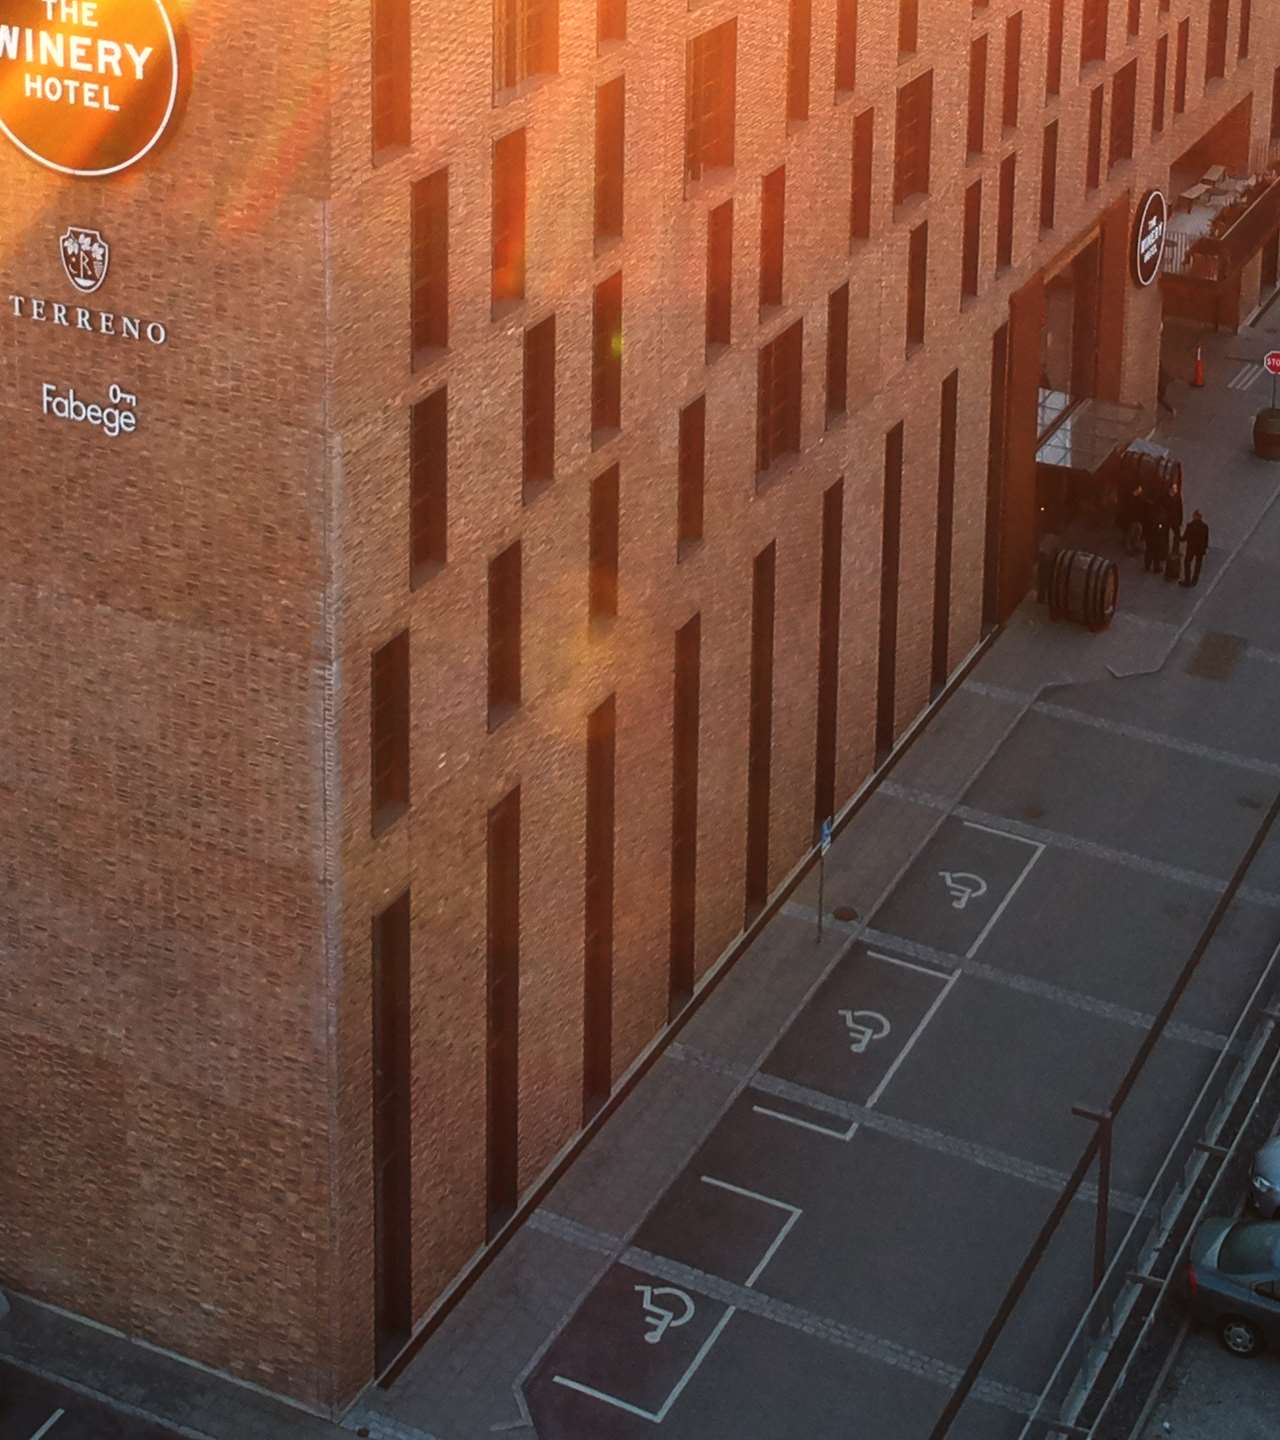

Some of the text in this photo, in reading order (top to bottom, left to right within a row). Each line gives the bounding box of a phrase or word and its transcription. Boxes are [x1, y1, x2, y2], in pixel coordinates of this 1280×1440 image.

[25, 73, 120, 111] HOTEL
[9, 295, 166, 344] TERRENO
[43, 384, 136, 437] Fabege
